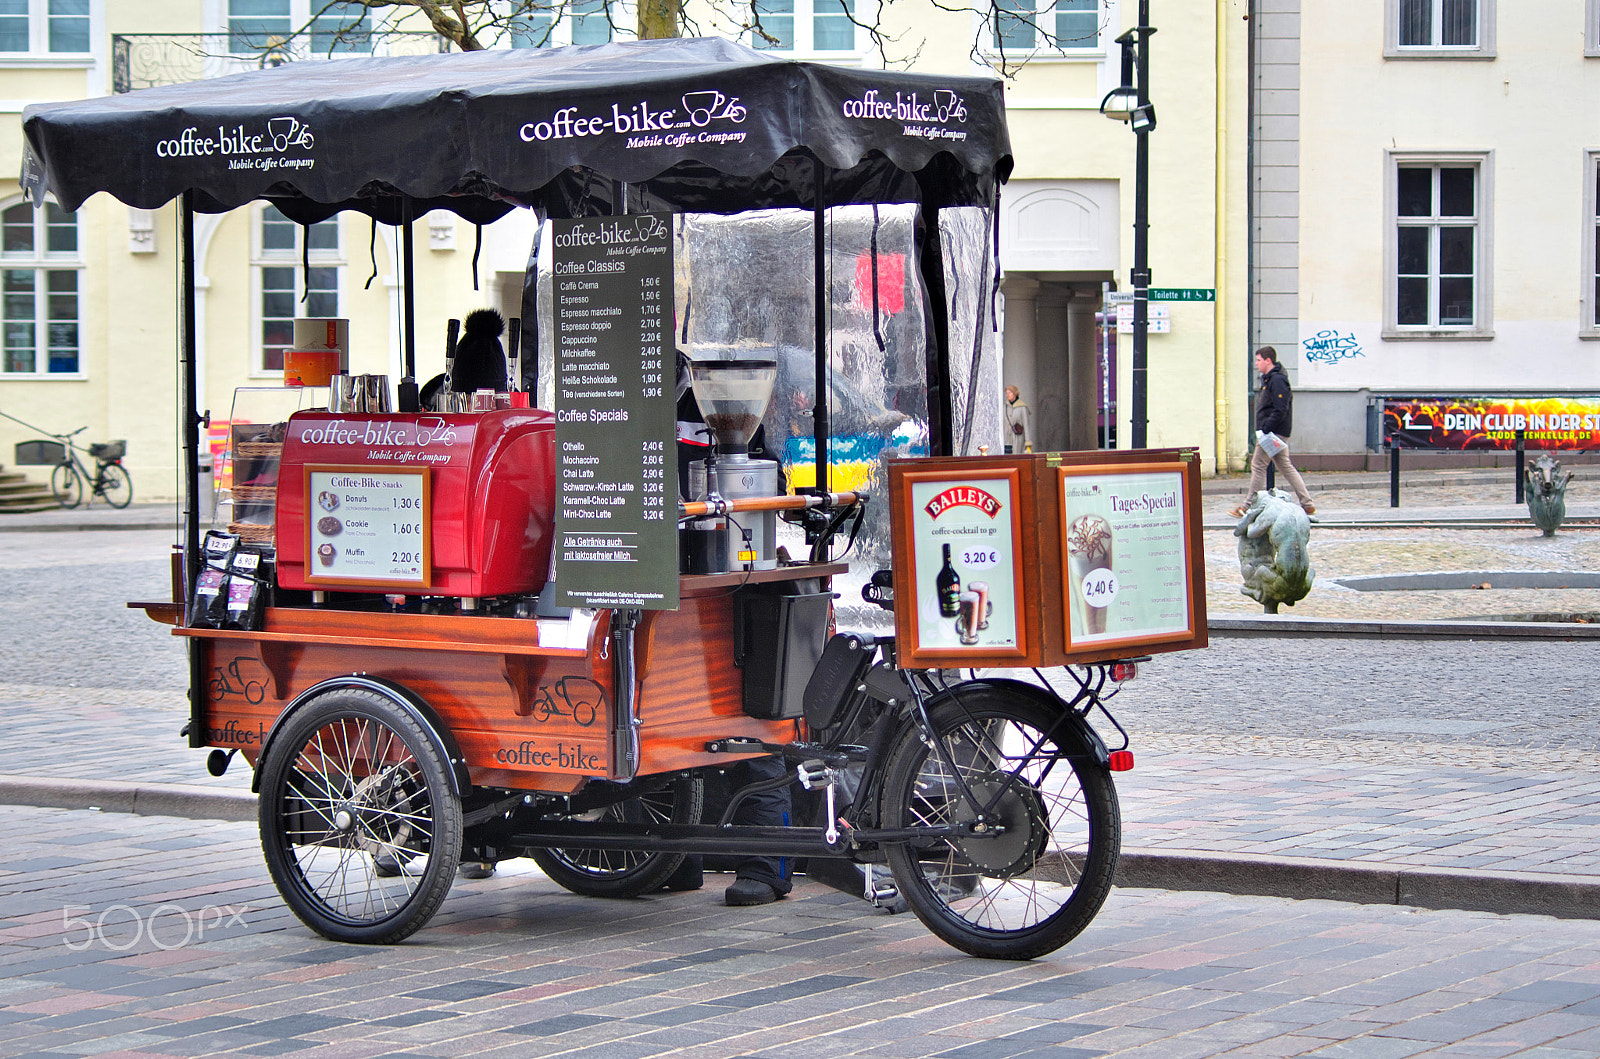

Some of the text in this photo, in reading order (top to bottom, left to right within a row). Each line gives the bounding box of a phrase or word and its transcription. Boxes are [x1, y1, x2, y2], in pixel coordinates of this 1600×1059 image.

[903, 126, 966, 142] Mobile Coffee Company
[626, 131, 747, 149] Mobile Coffee Company
[228, 157, 314, 171] Mobile Coffee Company
[606, 245, 667, 256] Mobile Coffee Company
[556, 260, 625, 274] Coffee Classics
[578, 281, 599, 290] Crema
[640, 278, 654, 288] 1,50
[560, 295, 589, 305] Espresso
[640, 292, 654, 301] 1,50
[1153, 291, 1178, 299] Toilette
[561, 309, 590, 319] Espresso
[590, 307, 622, 317] macchiato
[641, 306, 655, 315] 1,70
[561, 322, 590, 332] Espresso
[590, 322, 612, 331] doppio
[640, 320, 655, 329] 2,70
[561, 336, 597, 346] Cappuccino
[641, 333, 655, 342] 2,20
[562, 349, 596, 357] Milchkaffee
[641, 347, 655, 356] 2,40
[562, 362, 578, 371] Latte
[578, 362, 609, 370] macchiato
[641, 361, 655, 370] 2,60
[582, 375, 617, 384] Schokolade
[642, 374, 655, 383] 1,90
[562, 390, 574, 398] Tee
[642, 388, 656, 397] 1,90
[558, 409, 629, 424] Coffee Specials
[1444, 414, 1481, 430] DEIN
[1484, 414, 1526, 430] CLUB
[1530, 414, 1546, 430] IN
[1550, 414, 1582, 430] DER
[1486, 431, 1591, 440] STUDETENKELLER.DE
[563, 442, 584, 451] Othello
[643, 442, 657, 452] 2,40
[367, 451, 451, 464] Mobile Coffee Company
[563, 456, 599, 465] Mochaccino
[643, 456, 657, 465] 2,60
[563, 469, 577, 478] Chai
[578, 469, 594, 478] Latte
[643, 469, 657, 479] 2,90
[331, 477, 381, 488] Coffee-Bike
[563, 483, 617, 492] Schwarzw.-Kirsch
[618, 483, 634, 492] Latte
[643, 483, 658, 493] 3,20
[393, 498, 412, 509] 1,30
[414, 498, 420, 509] €
[609, 497, 626, 505] Latte
[643, 497, 658, 506] 3,20
[928, 488, 996, 516] BAILEYS
[1110, 492, 1176, 515] Tages-Special
[563, 510, 595, 519] Mint-Choc
[596, 510, 611, 519] Latte
[643, 511, 658, 520] 3,20
[393, 523, 412, 535] 1,60
[415, 524, 420, 534] €
[931, 527, 979, 535] coffee-cocktail
[988, 528, 997, 536] go
[564, 537, 622, 546] Alle Getränke auch
[392, 552, 412, 563] 2,20
[415, 552, 420, 563] €
[564, 551, 574, 560] mit
[614, 551, 630, 560] Milch
[964, 552, 996, 564] 3,20 €
[1086, 579, 1113, 596] 2,40 €
